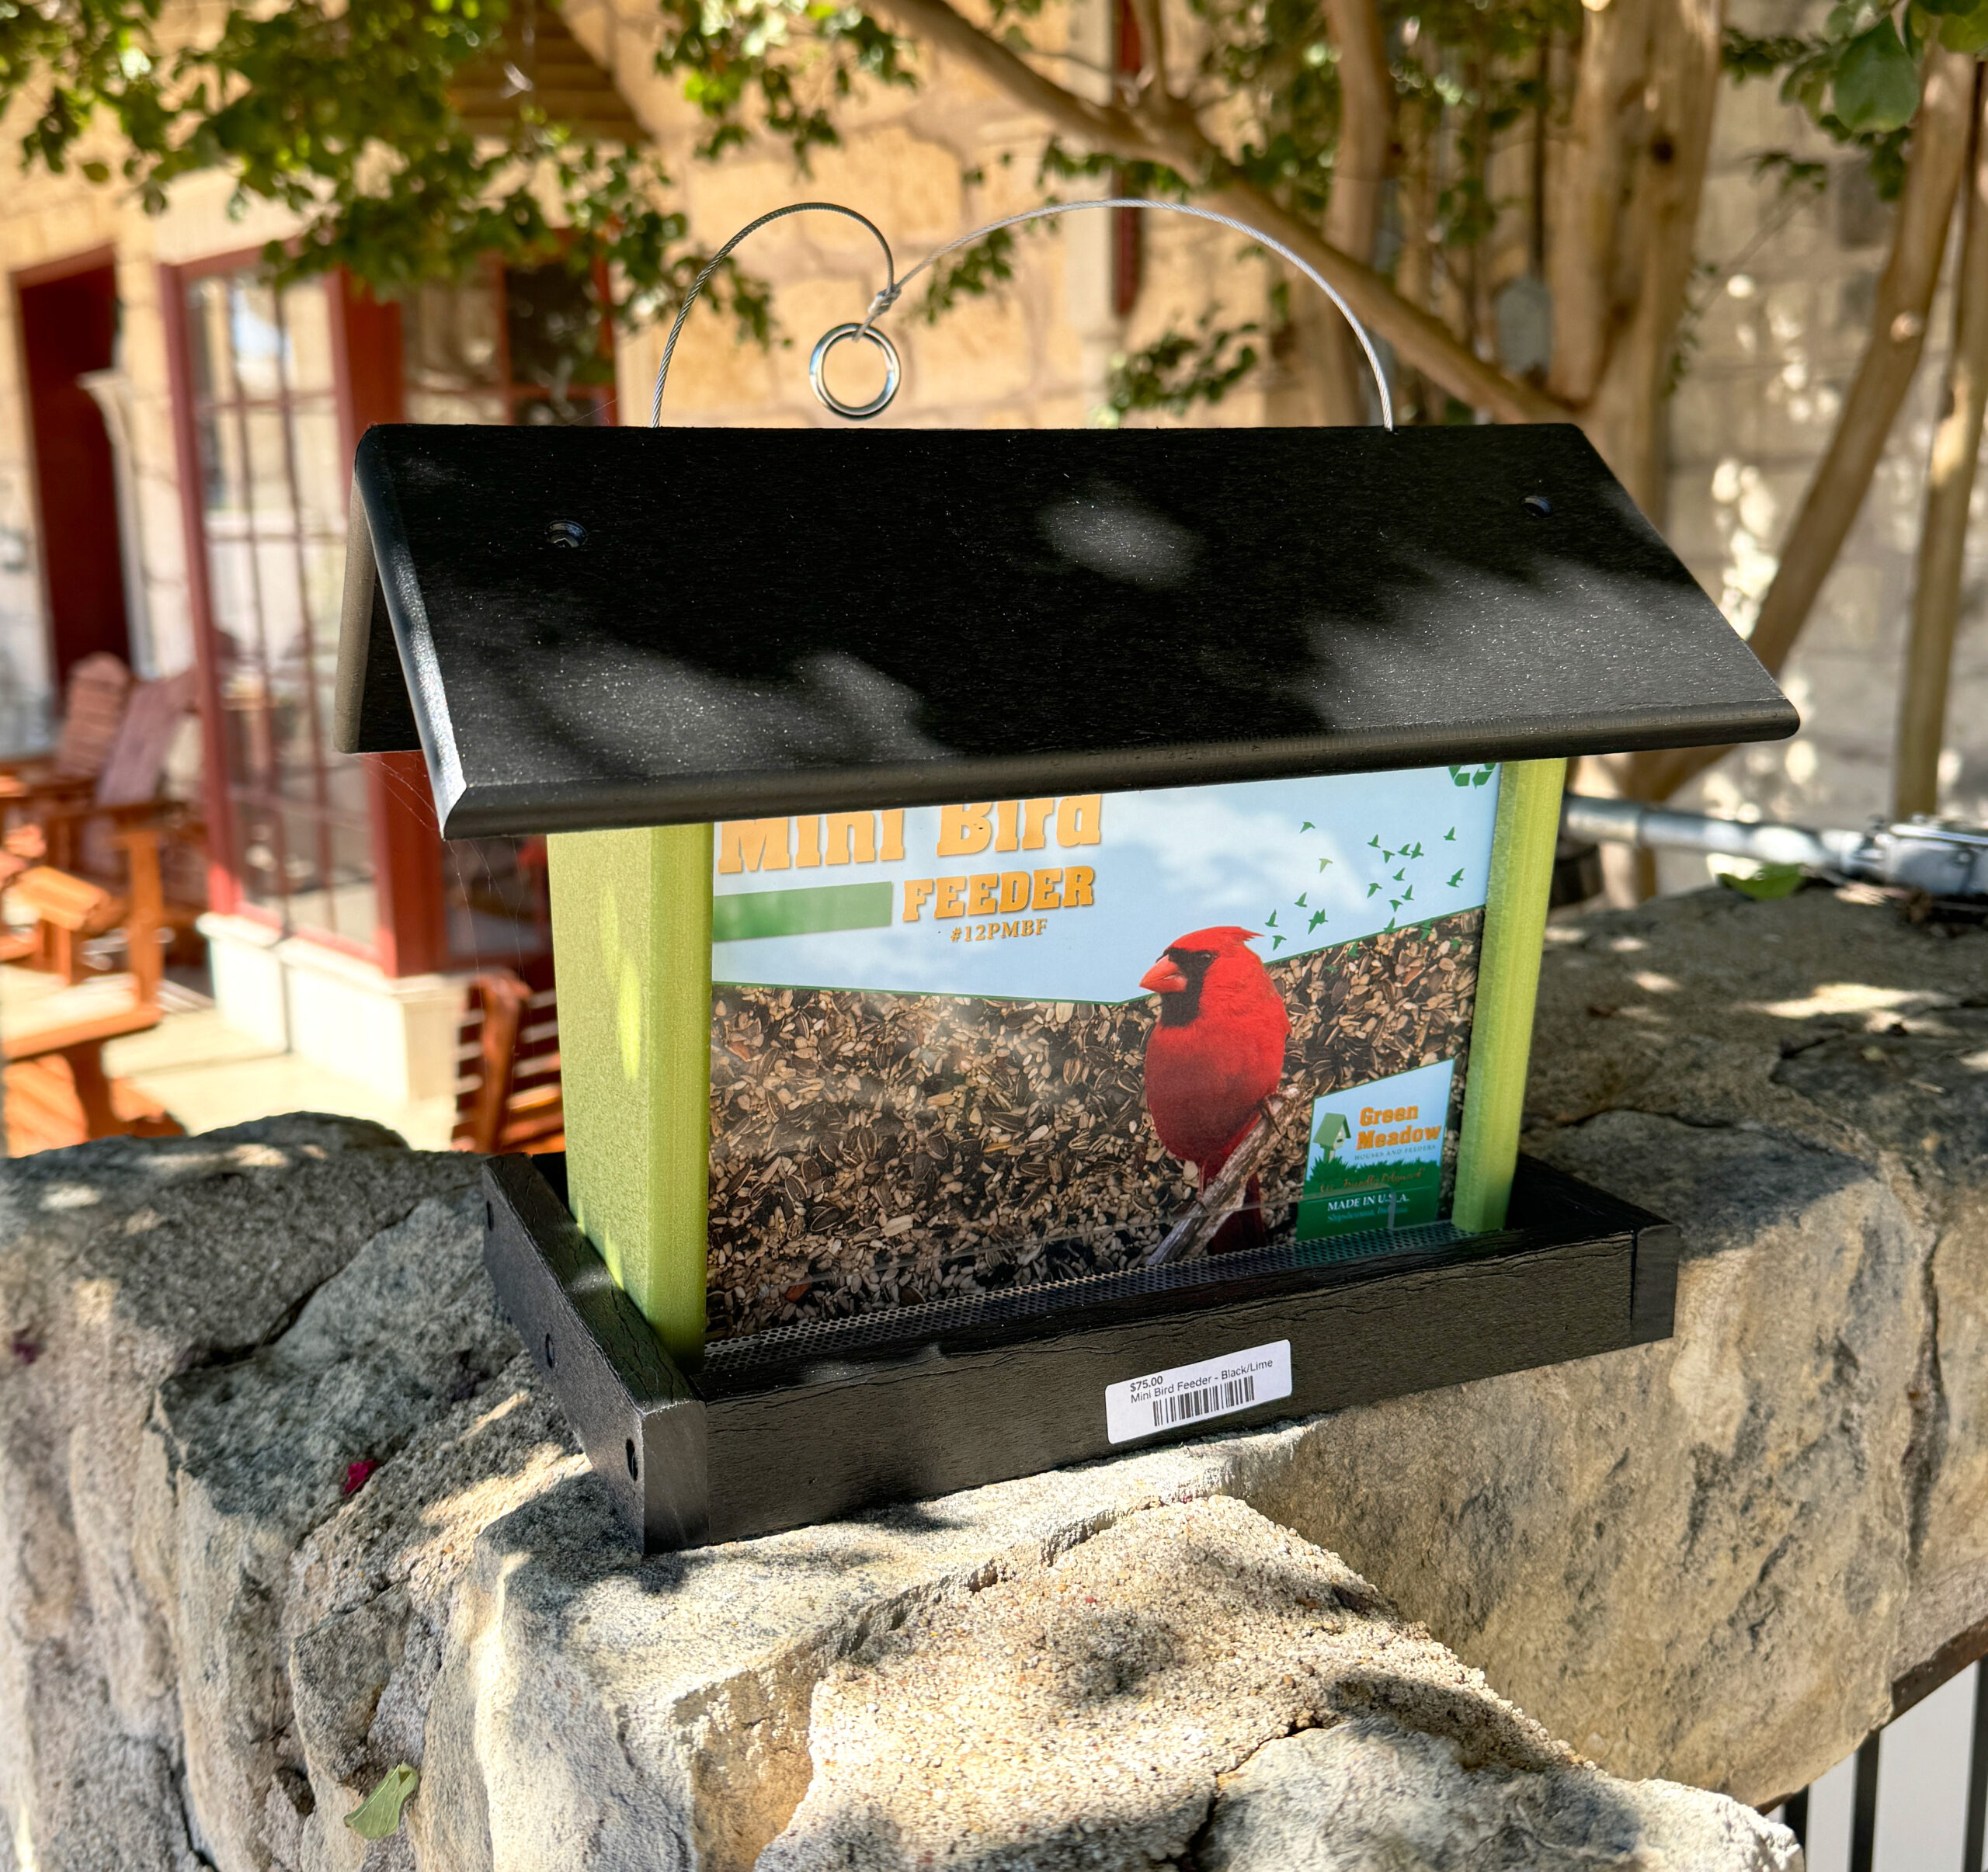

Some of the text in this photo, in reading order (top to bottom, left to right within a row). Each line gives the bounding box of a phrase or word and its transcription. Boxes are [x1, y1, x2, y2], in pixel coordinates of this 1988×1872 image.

[902, 865, 1096, 922] FEEDER
[950, 917, 1048, 943] #12PMBF
[1359, 1105, 1419, 1127] Green
[1356, 1124, 1442, 1151] Meadow
[1327, 1197, 1361, 1211] MADE
[1363, 1194, 1375, 1206] IN
[1130, 1375, 1163, 1392] $75.00
[1131, 1391, 1152, 1404] Mini
[1154, 1383, 1174, 1397] Bird
[1177, 1375, 1211, 1391] Feeder
[1221, 1359, 1274, 1380] Black/Lime
